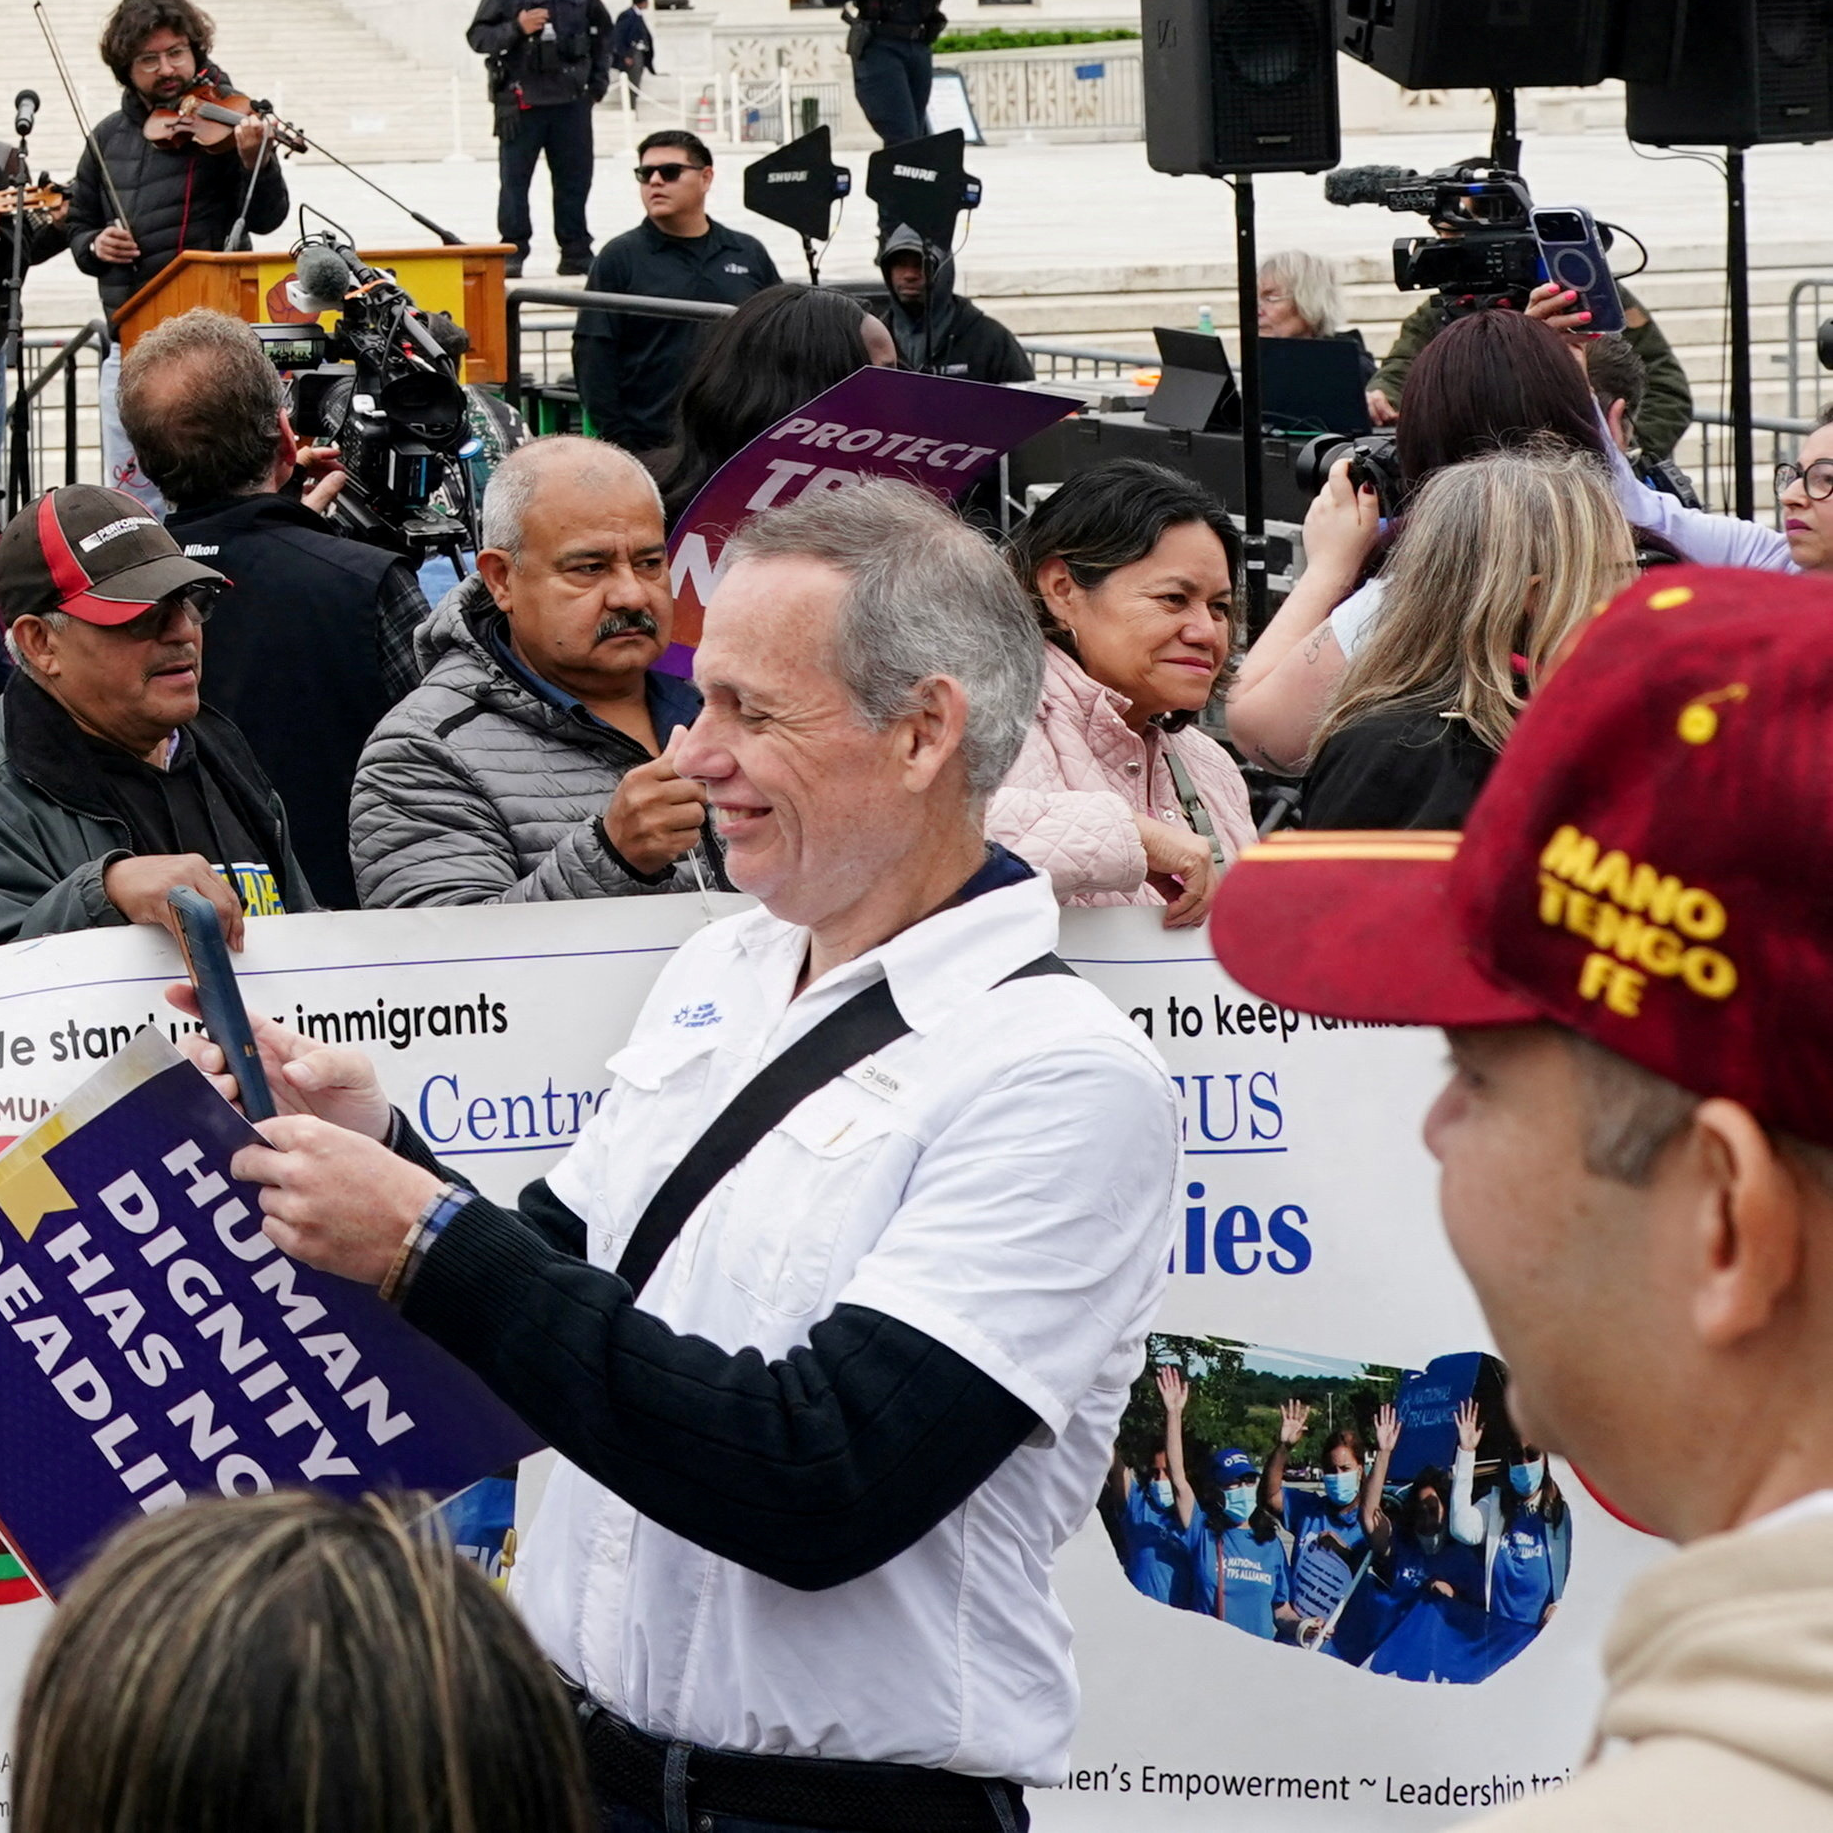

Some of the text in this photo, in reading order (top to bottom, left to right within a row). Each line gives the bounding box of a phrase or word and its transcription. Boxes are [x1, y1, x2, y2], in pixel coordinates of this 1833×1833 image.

[767, 170, 809, 184] SHURE
[892, 163, 938, 182] SHURE
[767, 416, 998, 472] PROTECT
[183, 543, 220, 558] Nikon
[1537, 823, 1729, 942] MANO
[1536, 868, 1739, 1002] TENGO
[1576, 951, 1649, 1019] FE
[48, 1013, 155, 1062] stan
[296, 992, 508, 1049] immigrants
[1167, 995, 1204, 1038] to
[1213, 993, 1300, 1043] keep
[160, 1138, 416, 1448] HUMAN
[97, 1168, 362, 1483] DIGNITY
[43, 1220, 277, 1499] HAS NO
[1226, 1568, 1273, 1587] TPS ALLIANCE
[1227, 1557, 1263, 1572] NATIONAL
[1141, 1765, 1351, 1802] Empowerment
[1385, 1773, 1526, 1809] Leadership
